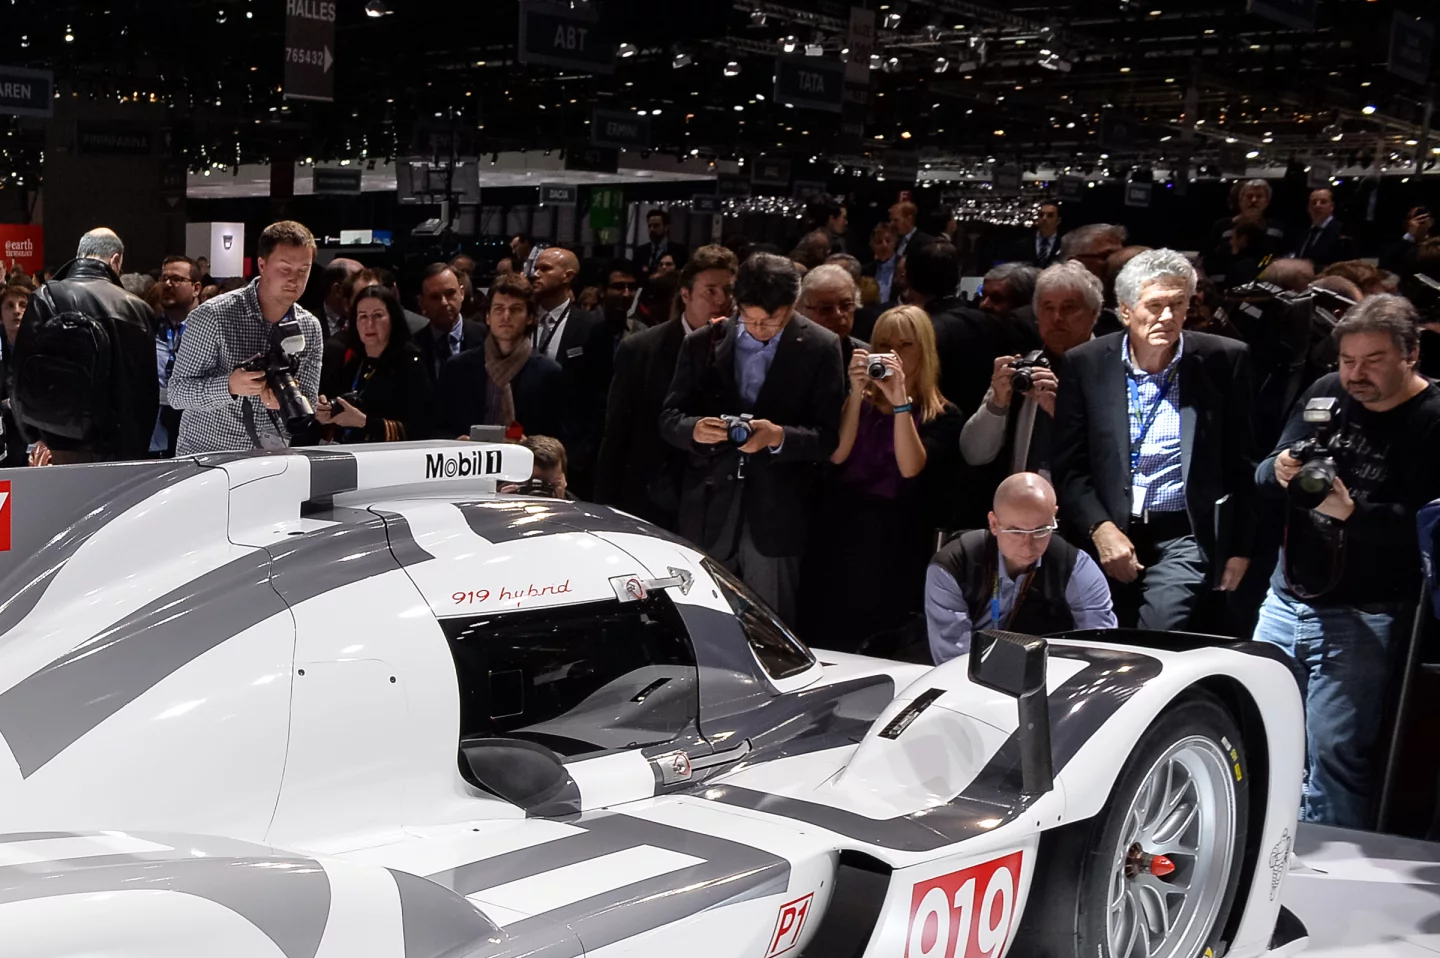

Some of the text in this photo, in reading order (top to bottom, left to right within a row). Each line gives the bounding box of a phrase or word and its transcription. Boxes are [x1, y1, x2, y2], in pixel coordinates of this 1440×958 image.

[286, 0, 336, 22] HALLES
[553, 24, 589, 52] ABT
[797, 70, 825, 94] TATA
[425, 450, 482, 479] Mobil
[452, 579, 573, 608] 919 hybrid
[770, 900, 806, 954] P1
